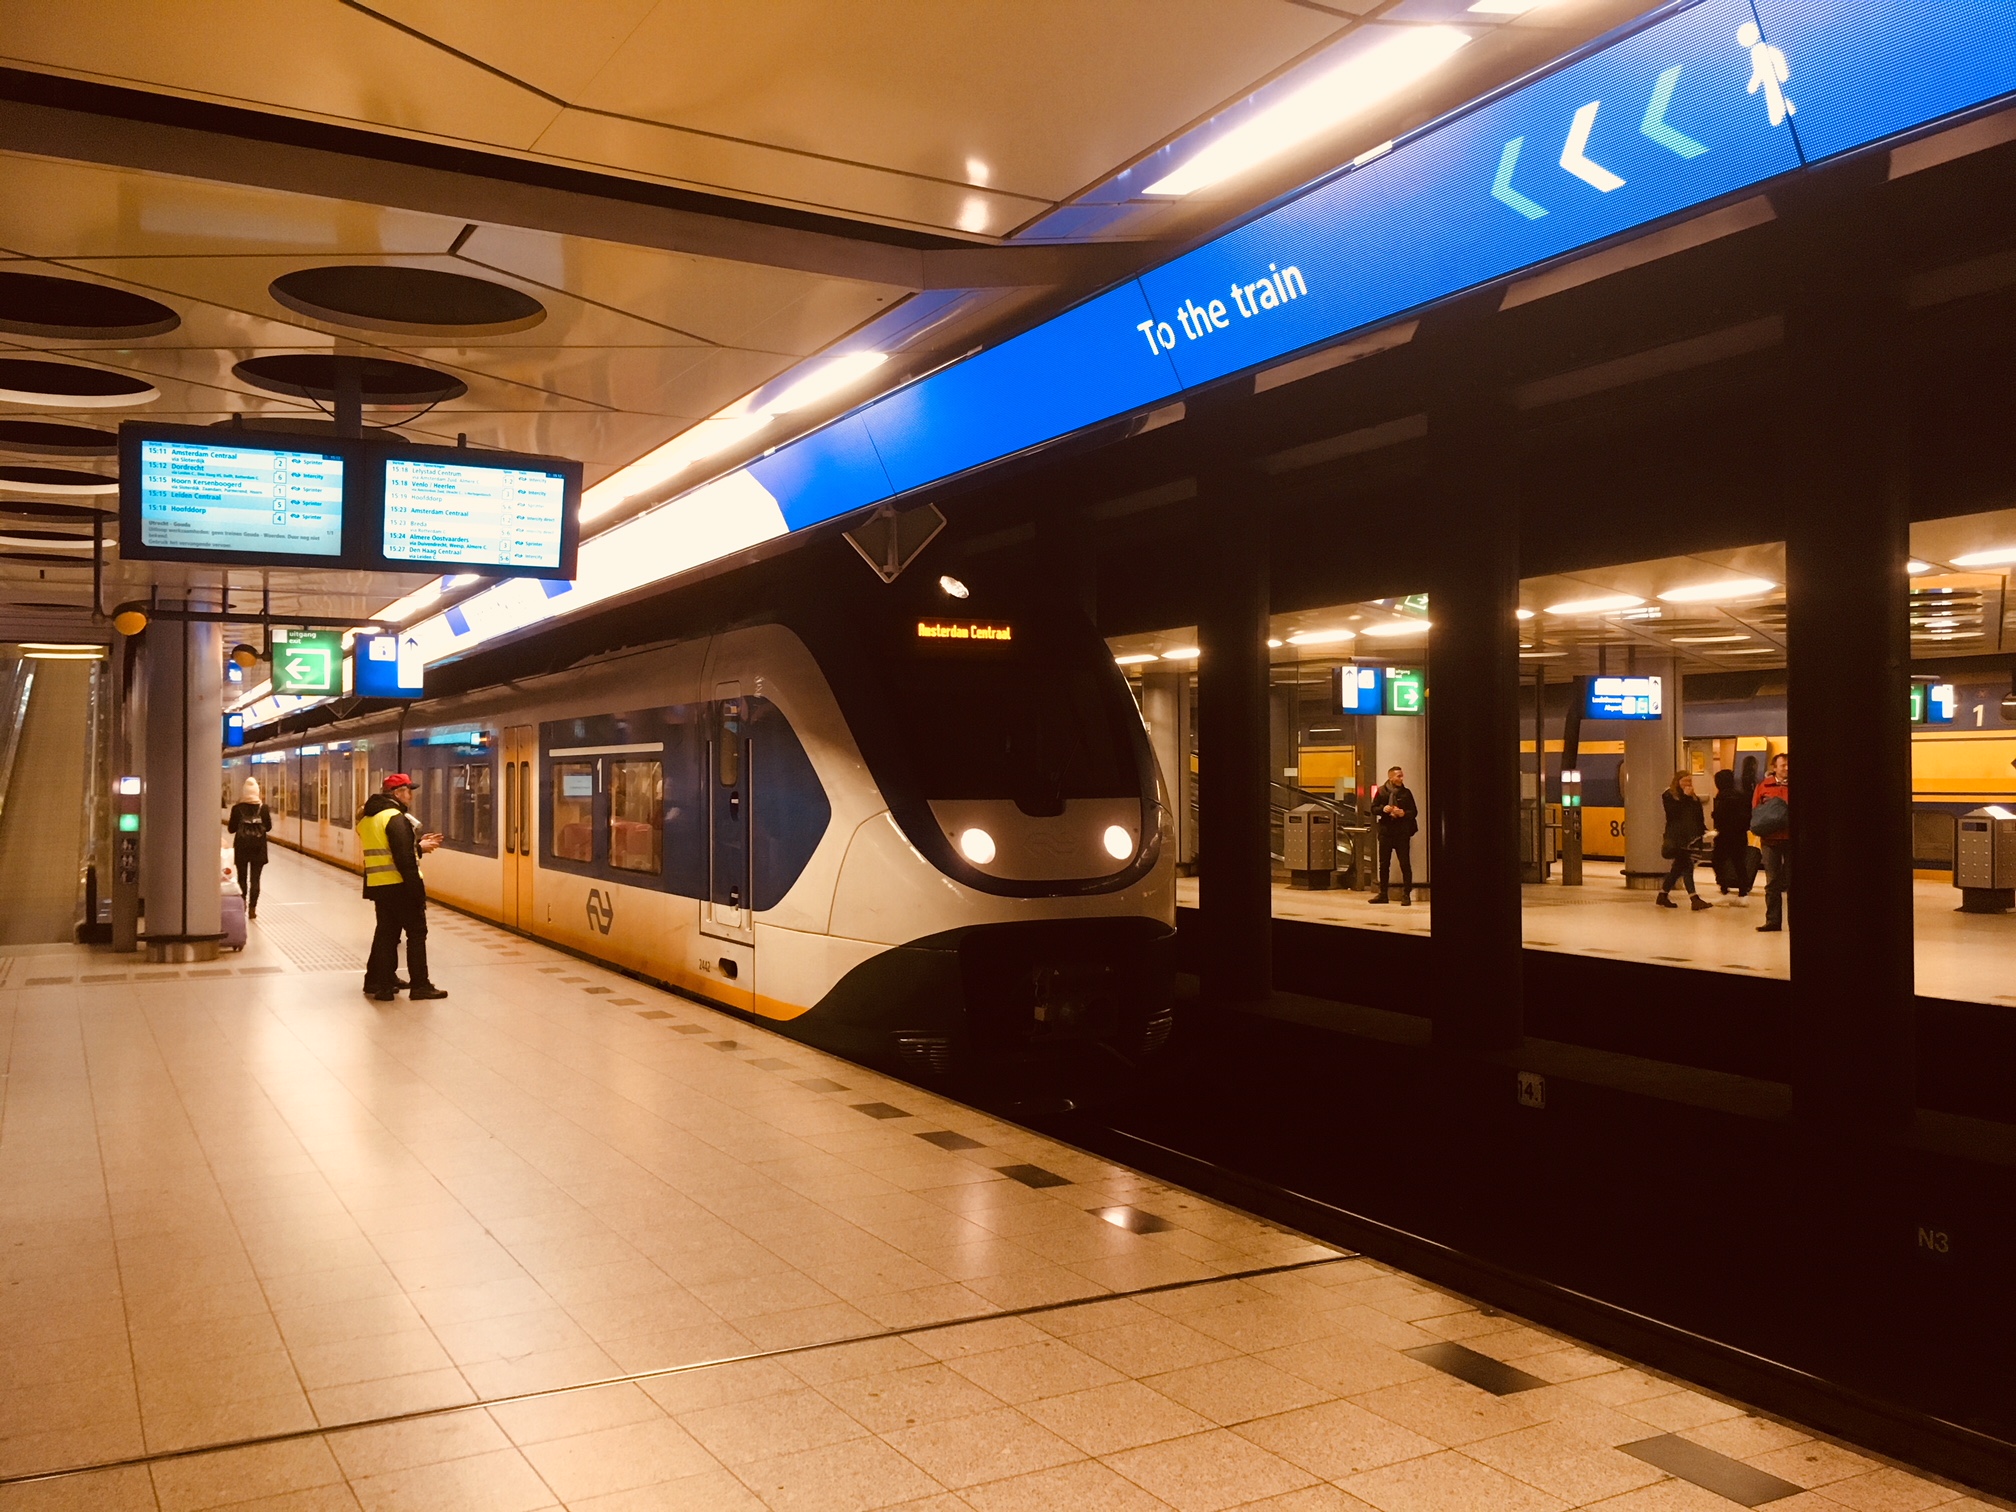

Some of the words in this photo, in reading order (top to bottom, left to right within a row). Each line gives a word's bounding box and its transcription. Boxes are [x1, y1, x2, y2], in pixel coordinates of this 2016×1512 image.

[1136, 319, 1176, 356] To
[1177, 298, 1230, 340] the
[1230, 263, 1308, 318] train
[171, 449, 209, 457] Amsterdam
[210, 451, 238, 460] Centraal
[148, 461, 167, 469] 15:12
[171, 463, 205, 472] Dordrecht
[193, 478, 242, 488] Kersenboogerd
[411, 494, 443, 503] Hoofddorp
[171, 506, 207, 514] Hoofddorp
[410, 507, 444, 515] Amsterdam
[431, 535, 469, 543] Oostvaarders
[289, 631, 317, 639] uitgang
[918, 622, 969, 638] Amsterdam
[970, 625, 1012, 640] Centraal
[1972, 704, 1984, 727] 1
[596, 758, 603, 793] 1
[1918, 1227, 1949, 1253] N3
